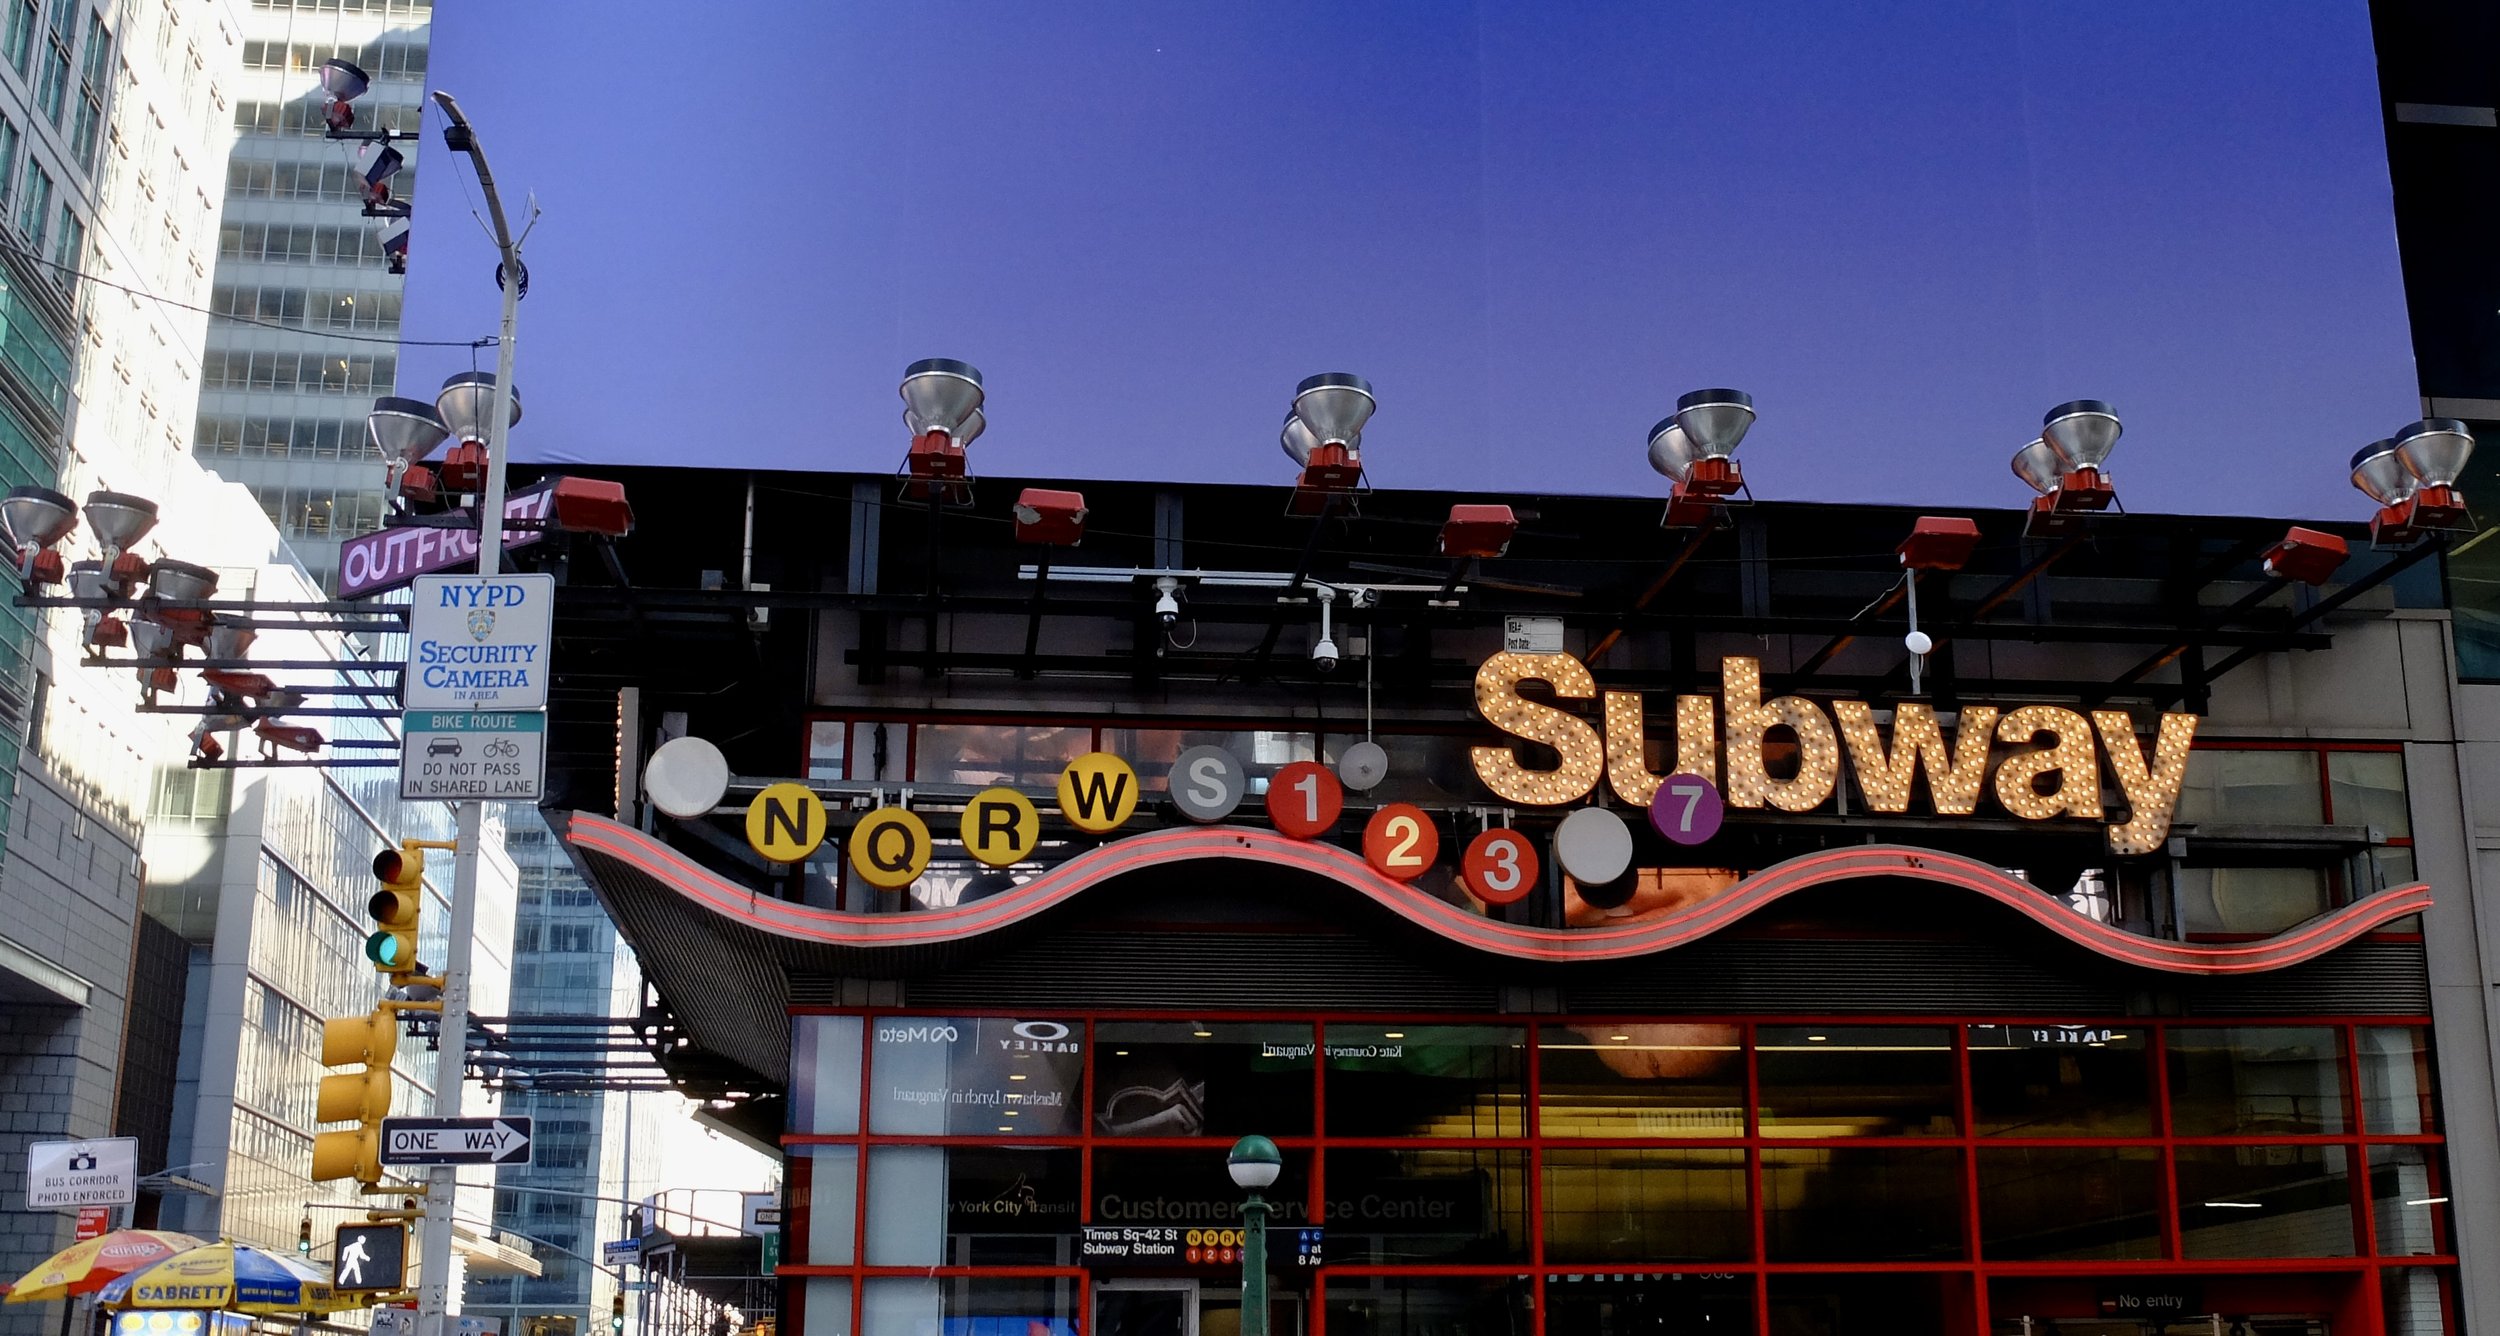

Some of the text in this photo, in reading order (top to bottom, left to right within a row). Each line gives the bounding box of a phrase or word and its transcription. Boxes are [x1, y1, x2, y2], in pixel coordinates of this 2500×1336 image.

[345, 489, 552, 587] OUTFRT/
[440, 585, 525, 607] NYPD
[419, 641, 537, 664] SECURITY
[423, 665, 529, 688] CAMERA
[454, 691, 499, 700] IN AREA
[431, 715, 517, 728] BIKE ROUTE
[1471, 651, 2199, 856] Subway
[423, 763, 521, 775] DO NOT PASS
[408, 781, 533, 793] IN SHARED LANE
[764, 757, 1704, 891] N Q R W S 1 2 3 7
[395, 1132, 511, 1150] ONE WAY
[45, 1174, 119, 1187] BUS CORRIDOR
[38, 1189, 125, 1202] PHOTO ENFORCED
[959, 1200, 990, 1213] York
[993, 1200, 1022, 1217] City
[1025, 1200, 1075, 1213] Transit
[1100, 1194, 1242, 1219] Customer
[1361, 1194, 1453, 1219] Center
[1084, 1229, 1118, 1240] Times
[1123, 1229, 1160, 1243] Sq-42
[1165, 1229, 1177, 1240] St
[1084, 1243, 1128, 1256] Subway
[1133, 1243, 1174, 1254] Station
[1311, 1244, 1321, 1254] at
[1298, 1255, 1321, 1265] 8 Av
[137, 1286, 228, 1300] SABRETT
[2120, 1293, 2183, 1310] No entry
